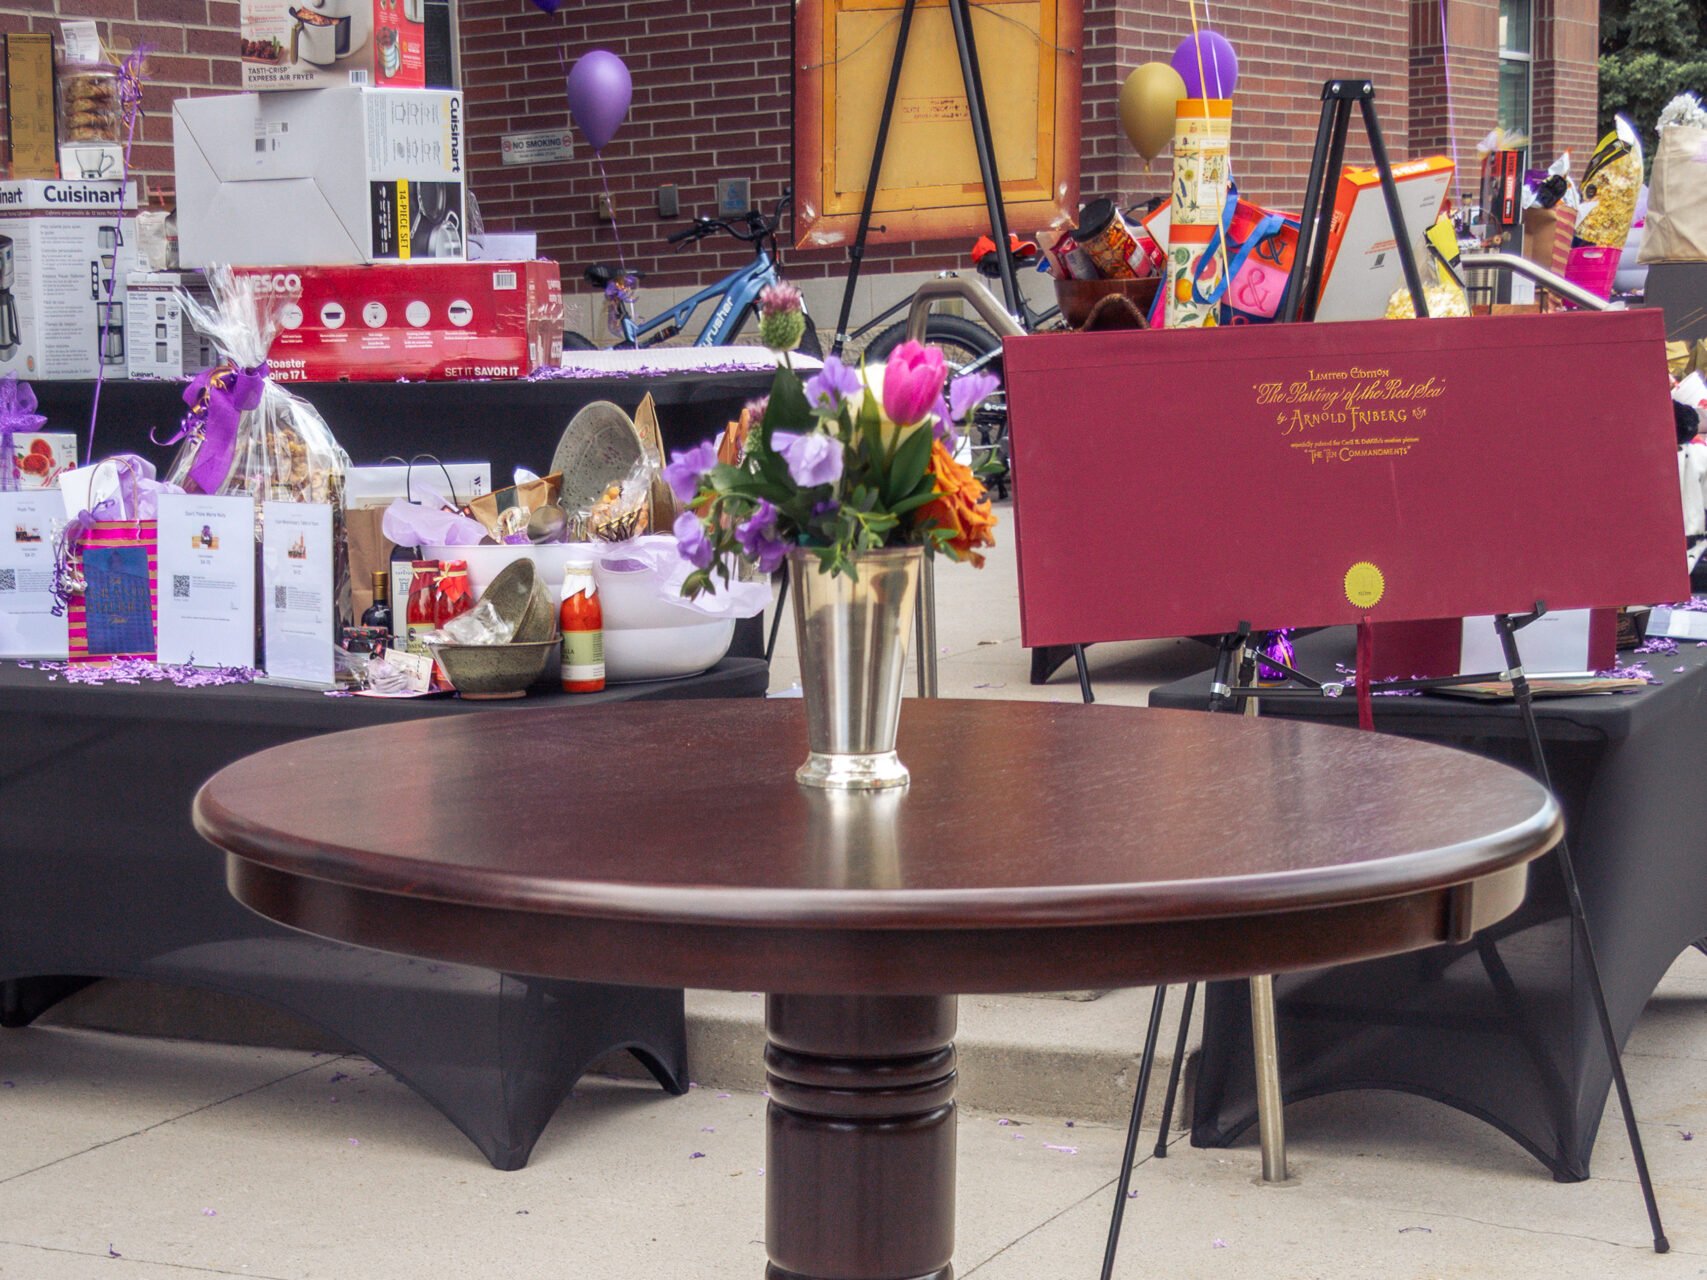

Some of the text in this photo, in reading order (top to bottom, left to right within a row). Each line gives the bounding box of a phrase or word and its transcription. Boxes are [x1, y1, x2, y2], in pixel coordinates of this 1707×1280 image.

[450, 97, 460, 173] Cuisinart
[512, 141, 524, 150] NO
[526, 138, 562, 149] SMOKING
[399, 190, 409, 249] 14-PIECE SET
[290, 370, 301, 380] 17
[445, 366, 520, 377] SET IT SAVOR IT
[1285, 381, 1343, 411] Parting
[1342, 382, 1361, 410] of
[1358, 380, 1385, 401] the
[1382, 379, 1413, 401] Red
[1276, 412, 1288, 425] by
[1281, 409, 1347, 436] ARNOLD
[1350, 406, 1408, 433] FRIBERG
[1323, 448, 1337, 463] TEN
